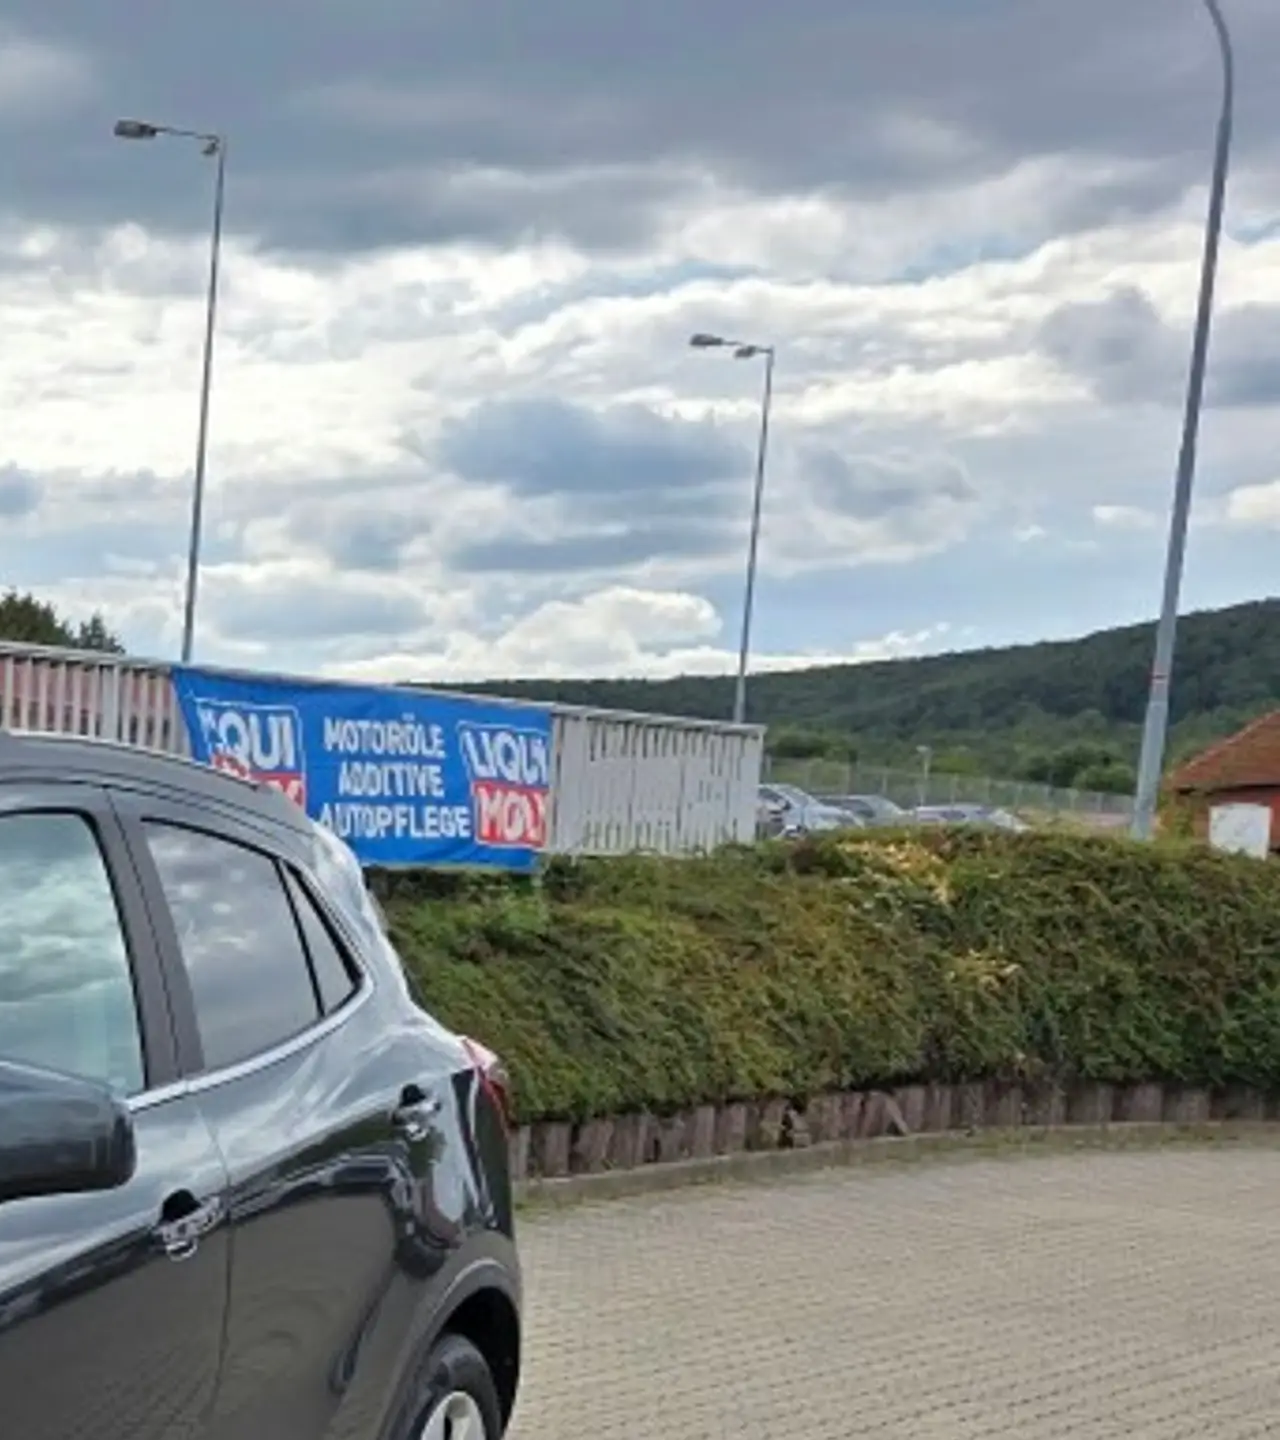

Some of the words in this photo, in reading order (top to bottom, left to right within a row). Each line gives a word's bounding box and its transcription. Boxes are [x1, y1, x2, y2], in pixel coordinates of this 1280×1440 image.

[324, 712, 446, 759] MOTORÖLE
[338, 761, 445, 797] ADDITIVE
[319, 802, 472, 838] AUTOPFLEGE
